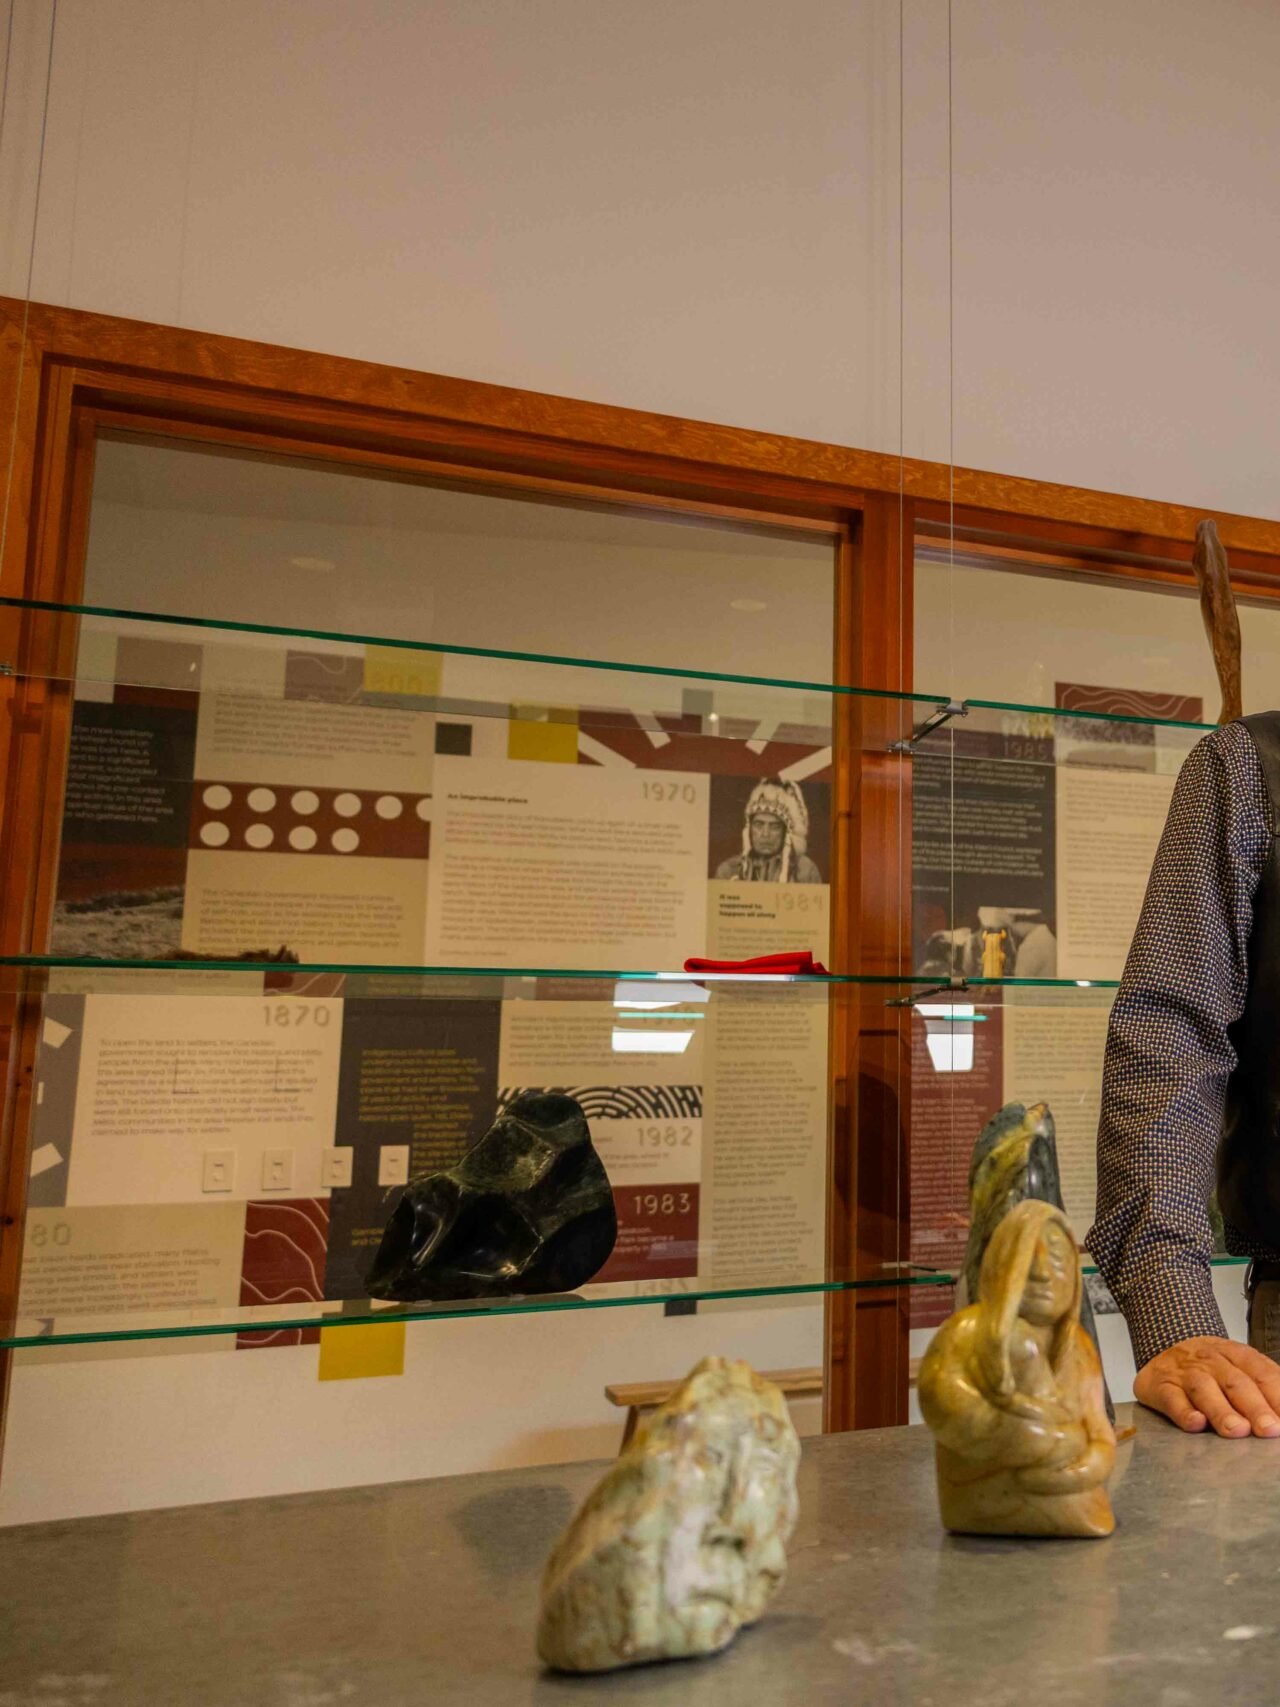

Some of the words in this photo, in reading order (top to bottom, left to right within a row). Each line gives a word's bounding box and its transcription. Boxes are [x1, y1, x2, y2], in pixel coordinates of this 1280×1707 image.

[641, 781, 697, 804] 1970
[263, 1005, 331, 1028] 1870
[637, 1126, 693, 1147] 1982
[633, 1193, 691, 1215] 1983
